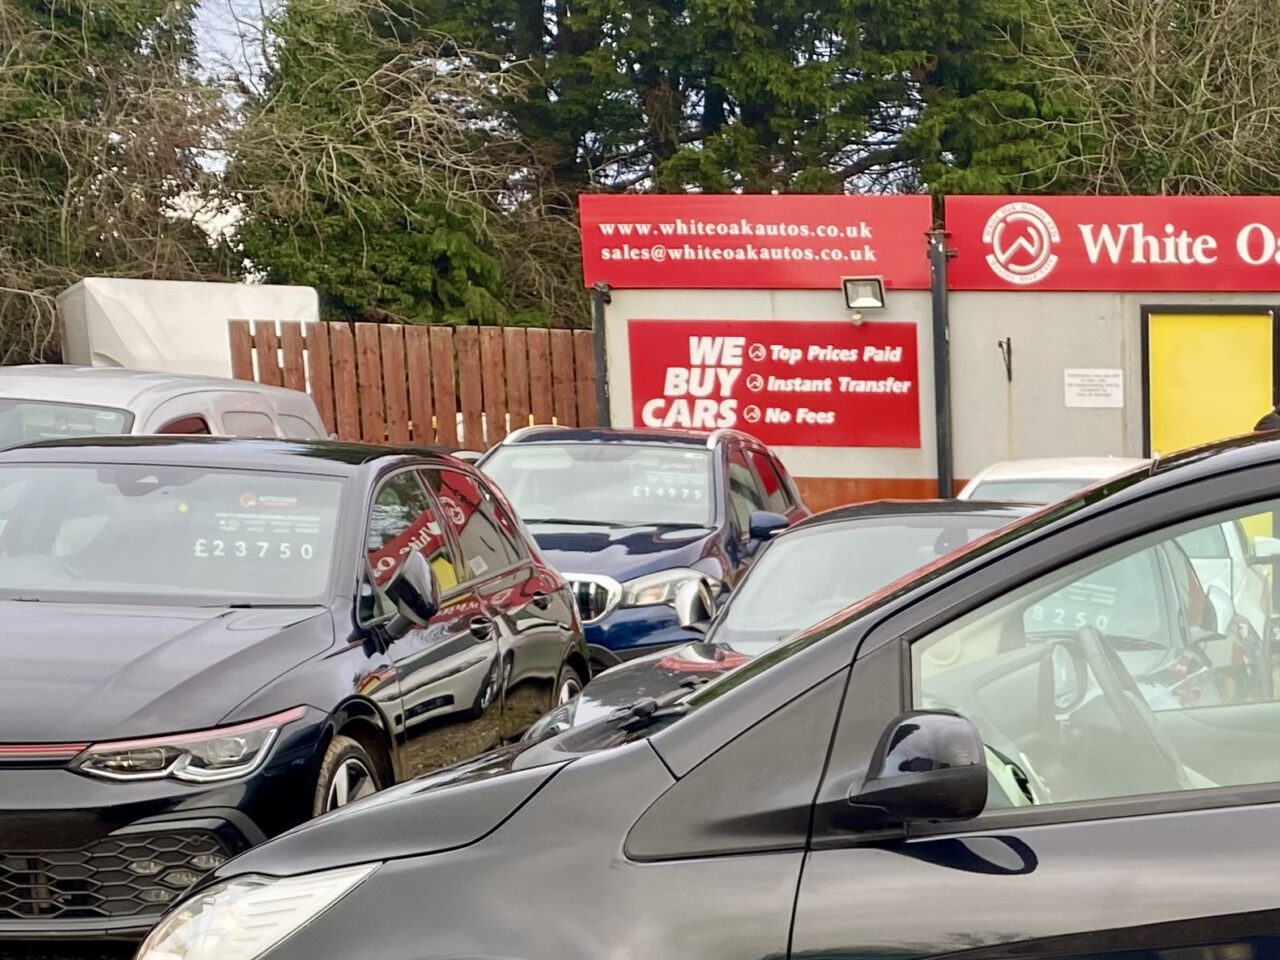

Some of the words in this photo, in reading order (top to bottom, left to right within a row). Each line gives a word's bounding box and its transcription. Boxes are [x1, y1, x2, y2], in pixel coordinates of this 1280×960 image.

[598, 218, 873, 239] www.whiteoakautos.co.uk
[601, 243, 877, 263] sales@whiteoakautos.co.uk
[1077, 222, 1218, 266] White
[689, 336, 746, 366] WE
[770, 344, 803, 365] Top
[807, 345, 858, 362] Prices
[863, 346, 902, 363] Paid
[664, 367, 742, 397] BUY
[767, 375, 832, 393] Instant
[838, 376, 912, 394] Transfer
[642, 398, 738, 428] CARS
[765, 407, 790, 424] No
[796, 408, 835, 425] Fees
[193, 538, 313, 560] £23750
